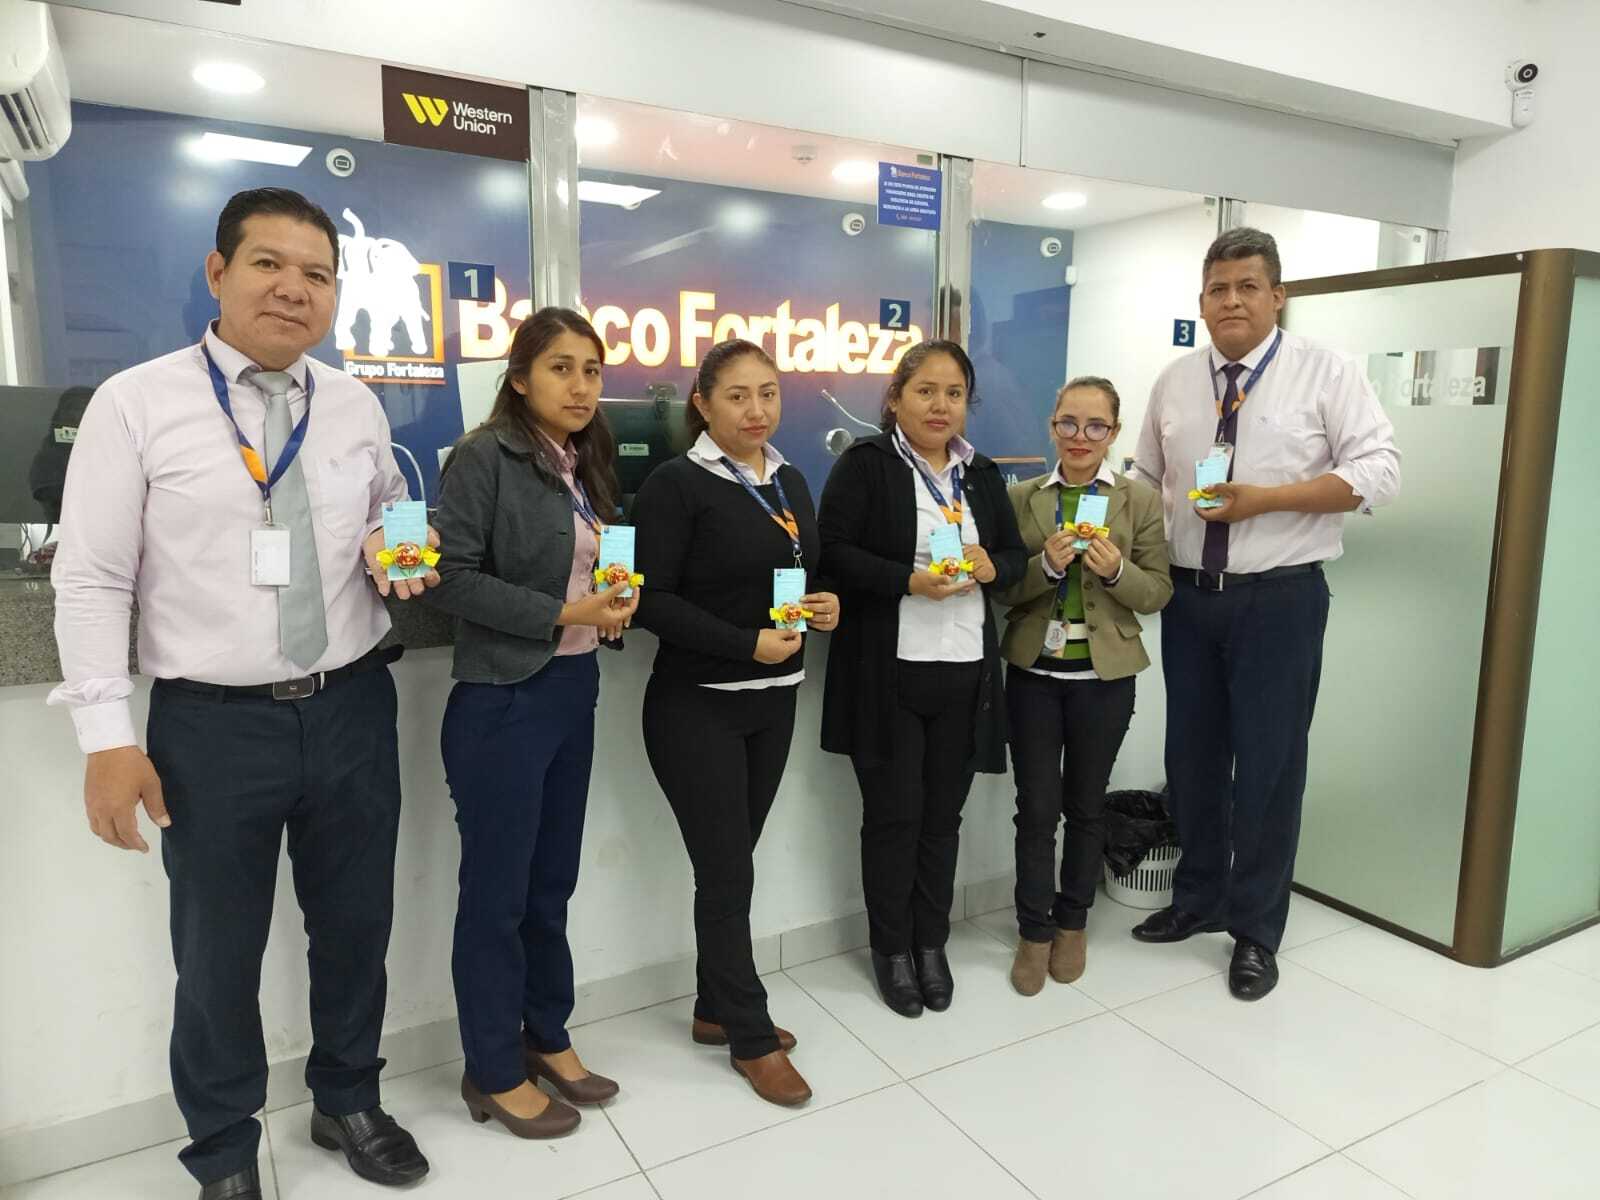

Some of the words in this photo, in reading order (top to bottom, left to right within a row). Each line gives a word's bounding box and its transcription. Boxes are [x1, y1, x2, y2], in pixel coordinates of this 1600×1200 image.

[452, 100, 513, 125] Western
[452, 115, 497, 136] Union
[463, 268, 480, 299] 1
[458, 275, 670, 367] Bco
[887, 303, 903, 328] 2
[1178, 322, 1190, 343] 3
[345, 360, 385, 379] Grupo
[387, 362, 445, 379] Fortaleza
